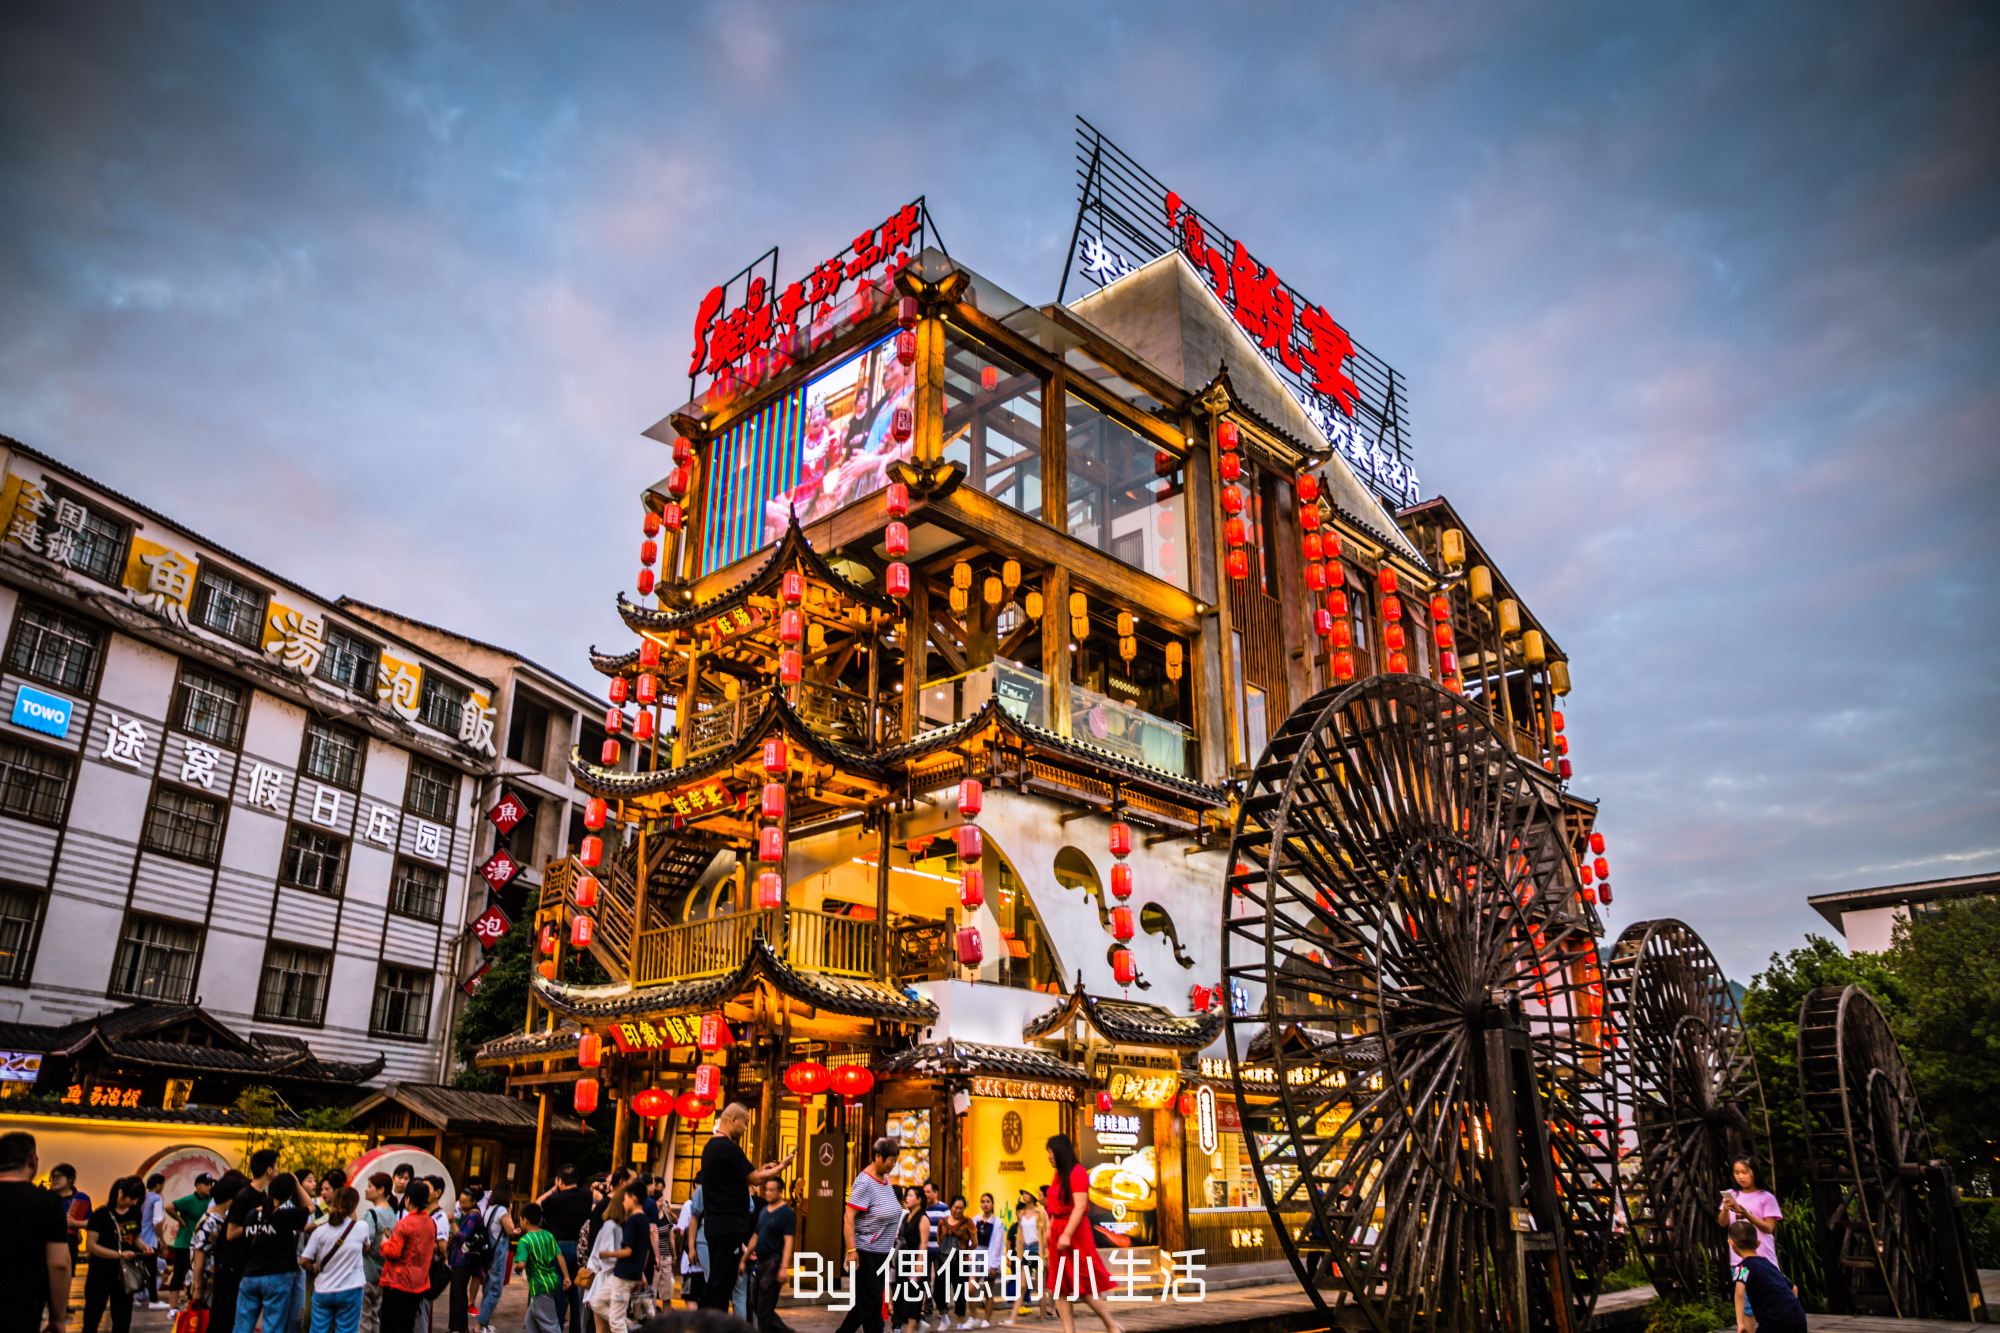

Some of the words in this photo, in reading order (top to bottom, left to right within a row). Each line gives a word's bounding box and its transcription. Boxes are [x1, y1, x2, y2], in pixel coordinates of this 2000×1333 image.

[22, 482, 88, 534] 全国
[8, 515, 78, 569] 连锁
[133, 551, 498, 758] 魚湯泡飯
[21, 698, 66, 726] TOWO
[101, 714, 442, 860] 途窝假日庄园
